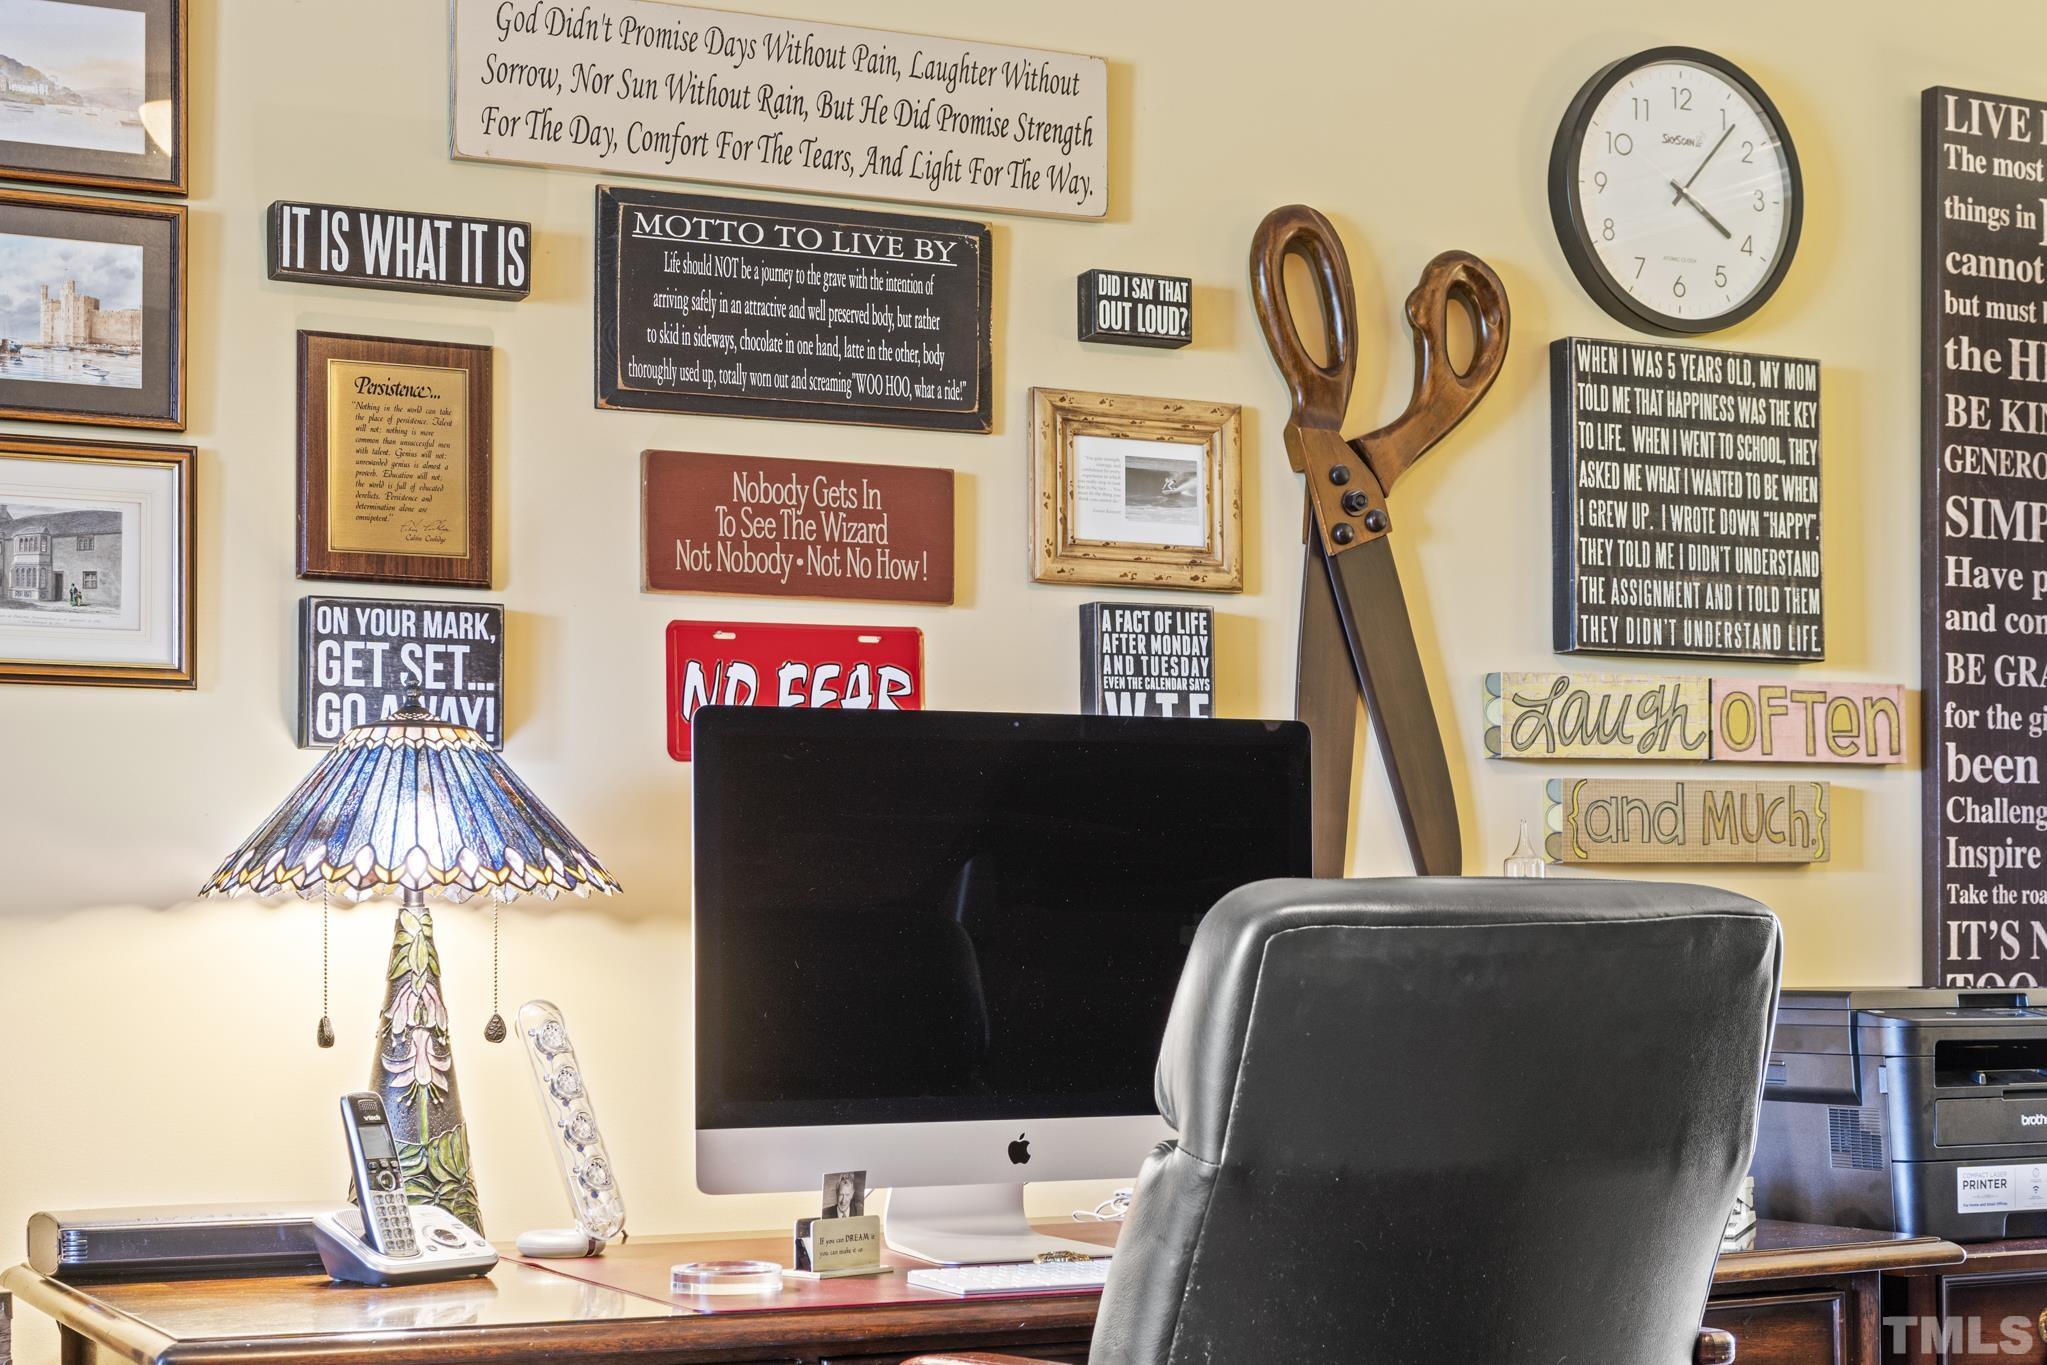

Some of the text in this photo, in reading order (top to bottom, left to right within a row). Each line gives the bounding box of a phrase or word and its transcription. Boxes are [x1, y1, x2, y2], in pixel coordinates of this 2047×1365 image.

[496, 0, 1080, 97] God Didn't Promise Days Without Pain, Laughter Without
[1632, 97, 1649, 121] 11
[1671, 87, 1692, 110] 12
[1720, 109, 1726, 131] 1
[1944, 95, 2031, 142] LIVE
[1606, 131, 1633, 156] 10
[1742, 141, 1753, 163] 2
[1944, 143, 2044, 182] The most
[1594, 172, 1607, 194] 9
[1753, 190, 1765, 212] 3
[1944, 195, 2036, 231] things in
[633, 212, 958, 262] MOTTO TO LIVE BY
[1603, 218, 1615, 240] 8
[283, 206, 525, 286] IT IS WHAT IT IS
[1740, 235, 1753, 256] 4
[664, 251, 935, 295] Life should NOT be a journey to the grave with the intention of
[1634, 257, 1645, 279] 7
[1715, 265, 1727, 287] 5
[1946, 252, 2045, 284] cannot
[1099, 274, 1188, 303] DID I SAY THAT
[1673, 275, 1686, 297] 6
[653, 287, 940, 332] arriving safely in an attractive and well preserved body, but rather
[1099, 300, 1188, 336] OUT LOUD?
[1944, 290, 2037, 323] but must
[1577, 344, 1816, 391] WHEN I WAS 5 YEARS OLD, MY MOM
[1944, 336, 2002, 374] the
[394, 404, 402, 412] the
[407, 405, 422, 414] world
[440, 407, 452, 415] take
[1578, 383, 1817, 428] TOLD ME THAT HAPPINESS WAS THE KEY
[1945, 394, 1991, 430] BE
[732, 471, 882, 514] Nobody Gets In
[715, 505, 888, 544] To See The Wizard
[675, 539, 712, 571] Not
[846, 547, 871, 578] No
[1945, 556, 2023, 591] Have
[317, 606, 495, 644] ON YOUR MARK,
[1102, 610, 1207, 634] A FACT OF LIFE
[1945, 604, 1997, 632] and
[1103, 633, 1208, 656] AFTER MONDAY
[317, 640, 494, 691] GET SET...
[1104, 655, 1209, 677] AND TUESDAY
[1945, 653, 1986, 685] BE
[1104, 676, 1210, 691] EVEN THE CALENDAR SAYS
[316, 692, 365, 738] GO
[1511, 675, 1706, 754] Laugh
[1945, 701, 2022, 730] for the
[1945, 742, 2040, 784] been
[1946, 796, 2047, 831] Challeng
[1946, 837, 2041, 877] Inspire
[1947, 884, 2017, 904] Take the
[1963, 1179, 2007, 1190] PRINTER
[846, 1233, 869, 1242] DREAM
